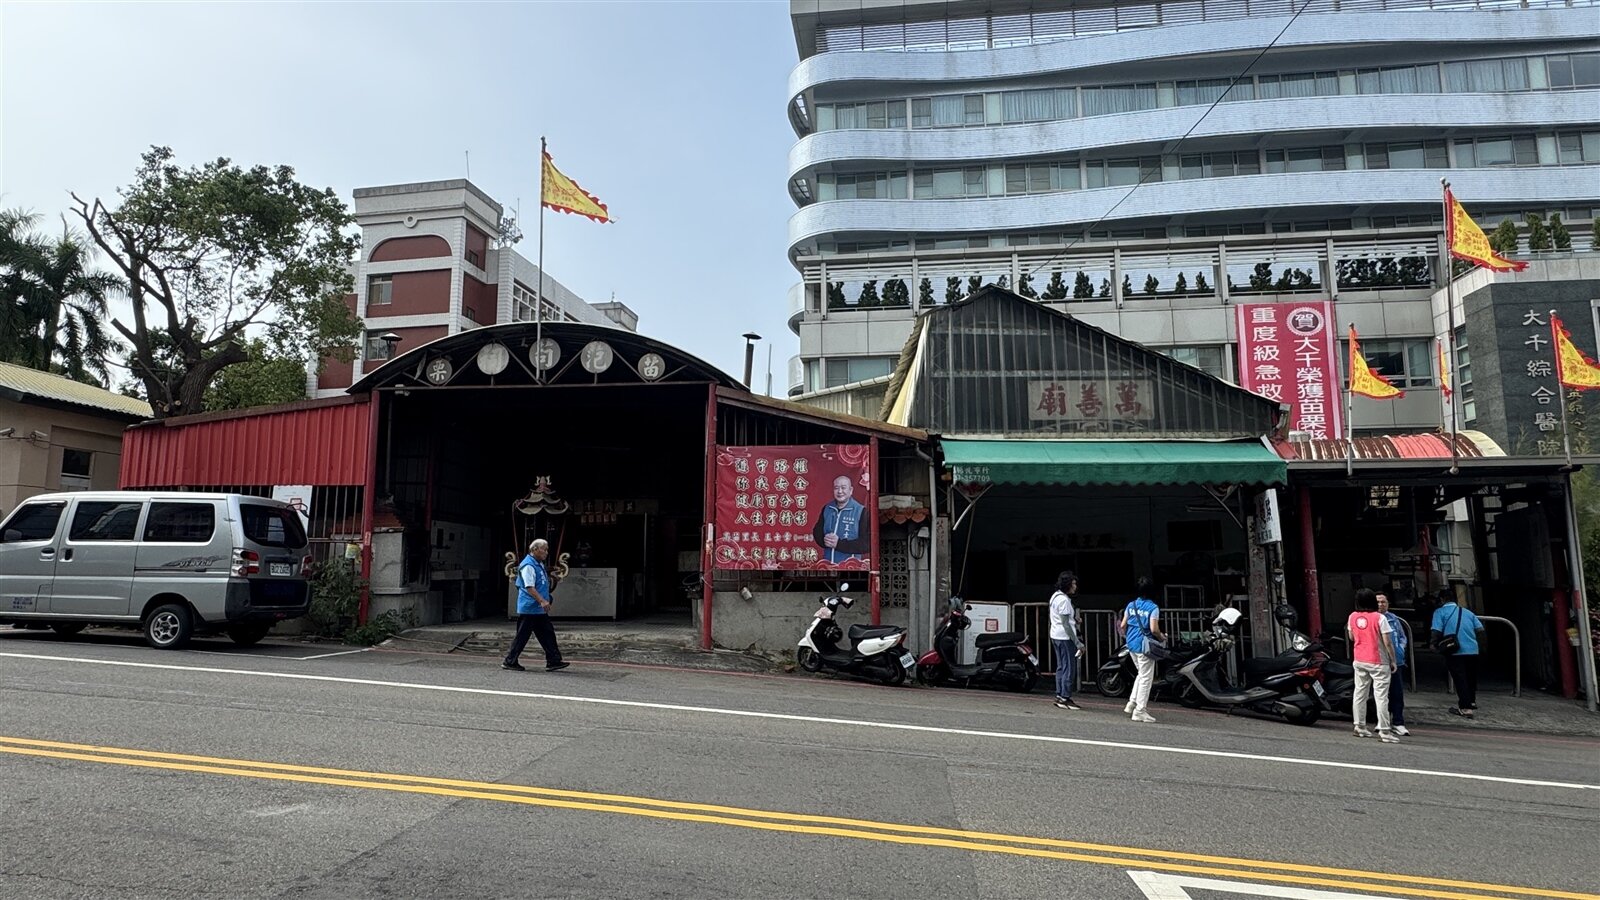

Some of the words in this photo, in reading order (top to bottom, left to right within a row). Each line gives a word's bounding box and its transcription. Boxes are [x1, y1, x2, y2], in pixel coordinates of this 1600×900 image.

[1295, 313, 1317, 329] 賀
[1251, 307, 1283, 400] 重度級急救
[1522, 308, 1561, 456] 大千綜合醫院
[1036, 381, 1142, 417] 萬善廟
[736, 476, 808, 491] 你我安全
[736, 493, 807, 508] 健康百分百
[735, 511, 807, 525] 人生才精彩
[725, 547, 818, 560] 祝大家新春愉快
